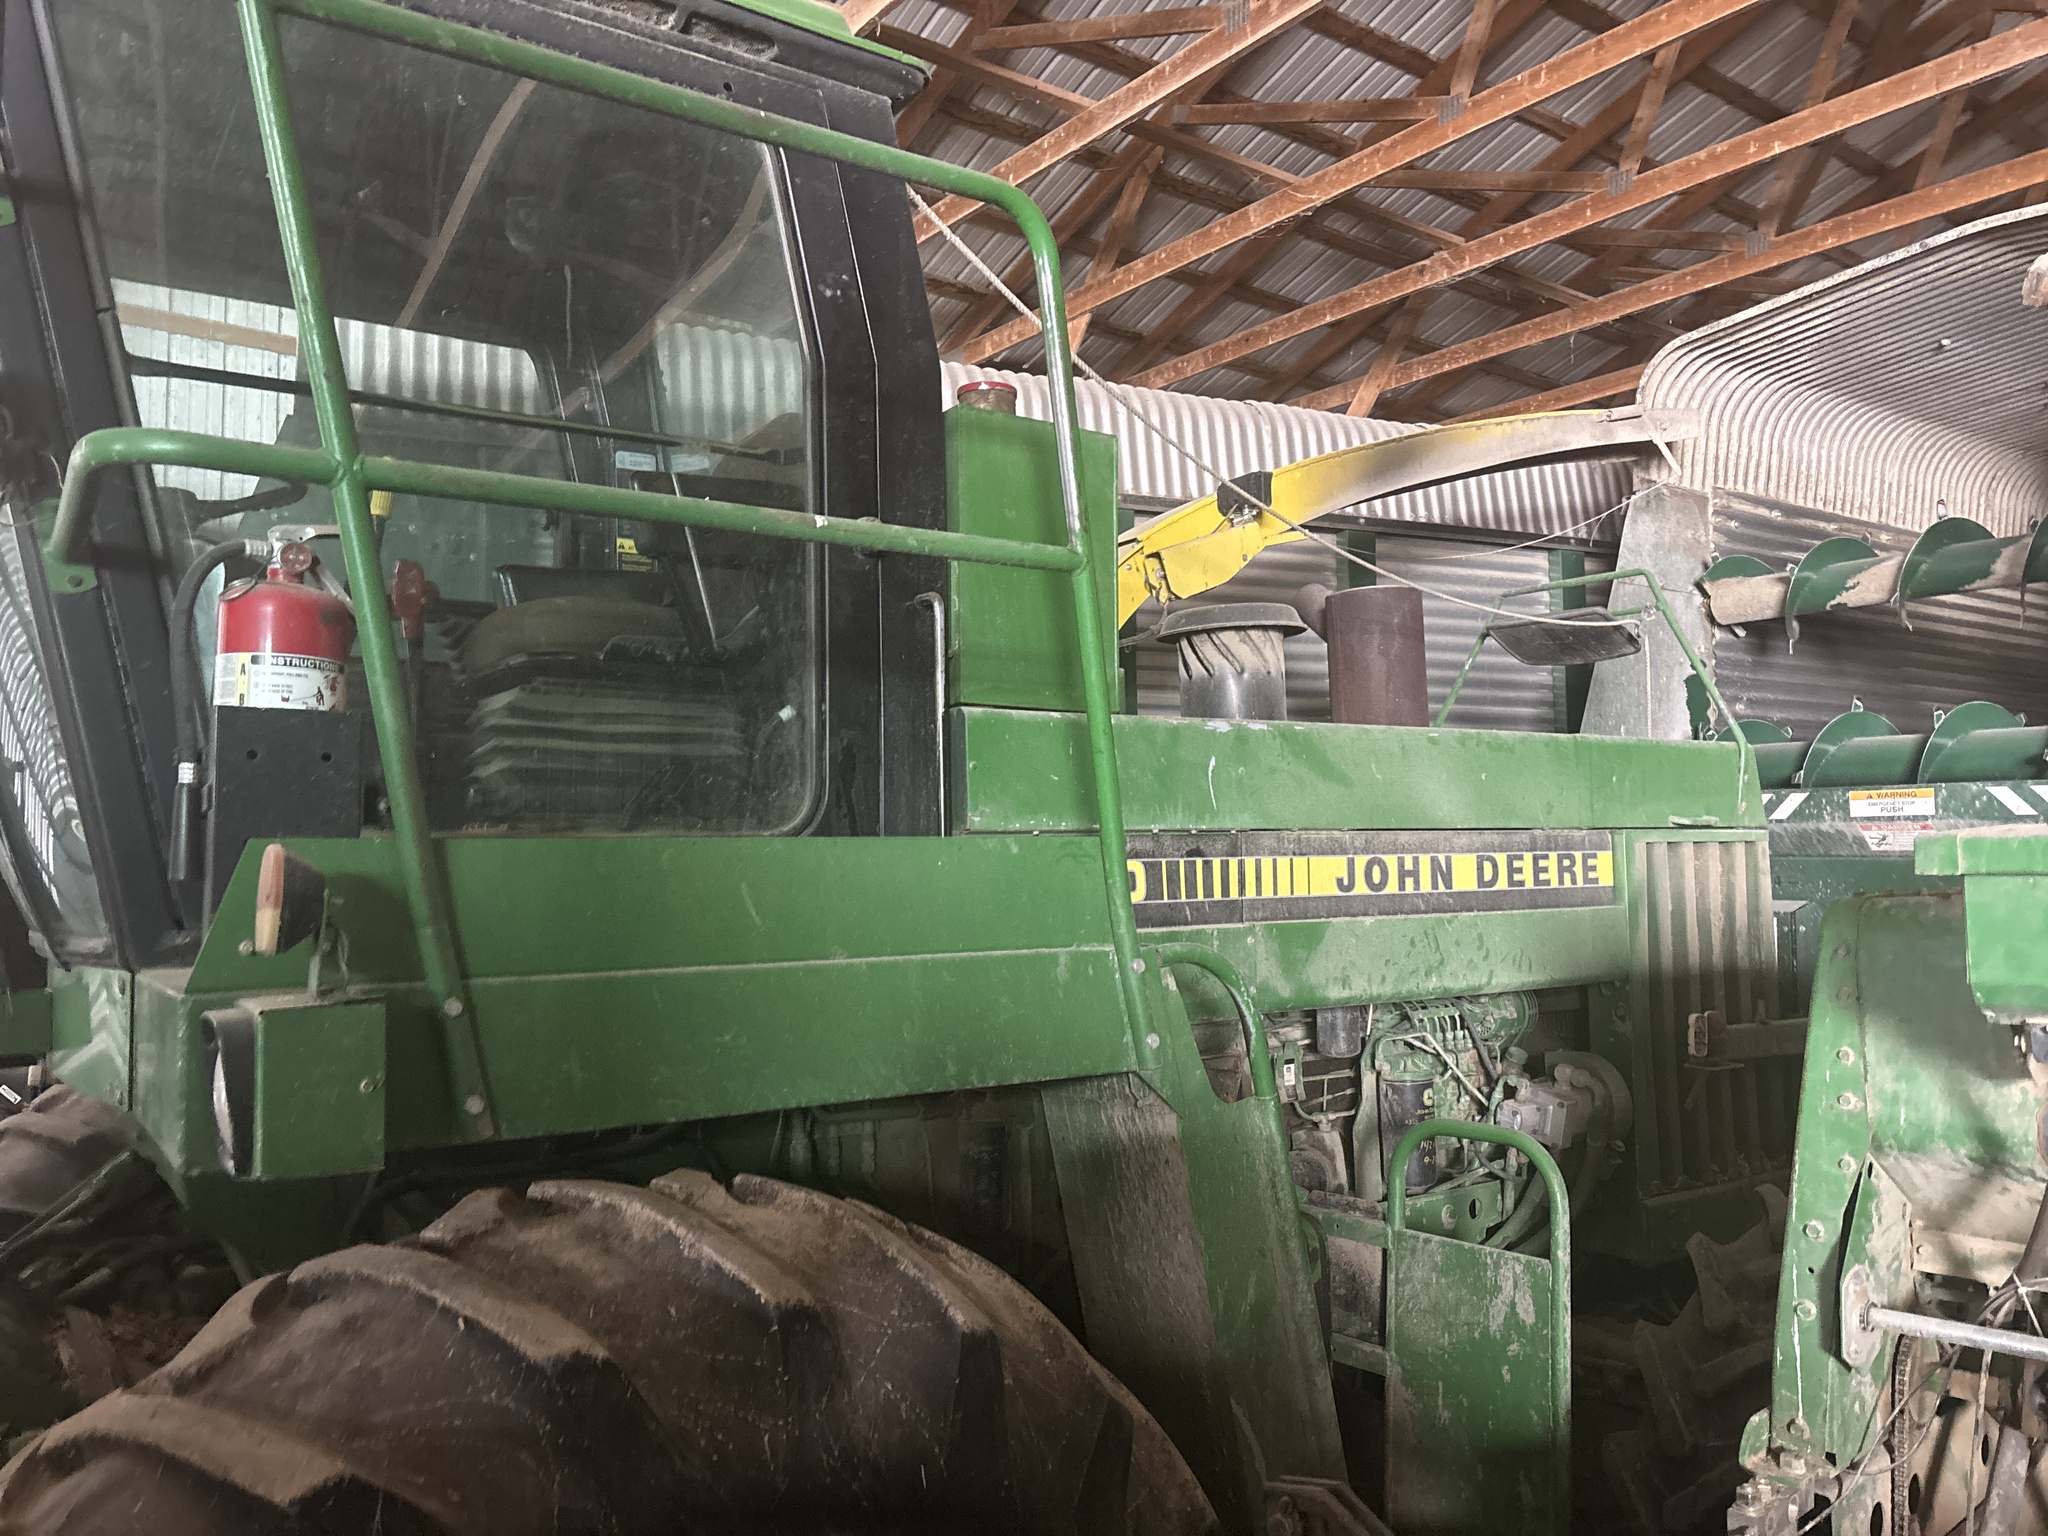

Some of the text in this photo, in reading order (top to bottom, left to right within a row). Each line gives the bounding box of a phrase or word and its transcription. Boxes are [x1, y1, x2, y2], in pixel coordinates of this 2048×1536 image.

[240, 663, 246, 676] A
[1876, 790, 1918, 799] WARNING
[1334, 852, 1600, 893] JOHN DEERE
